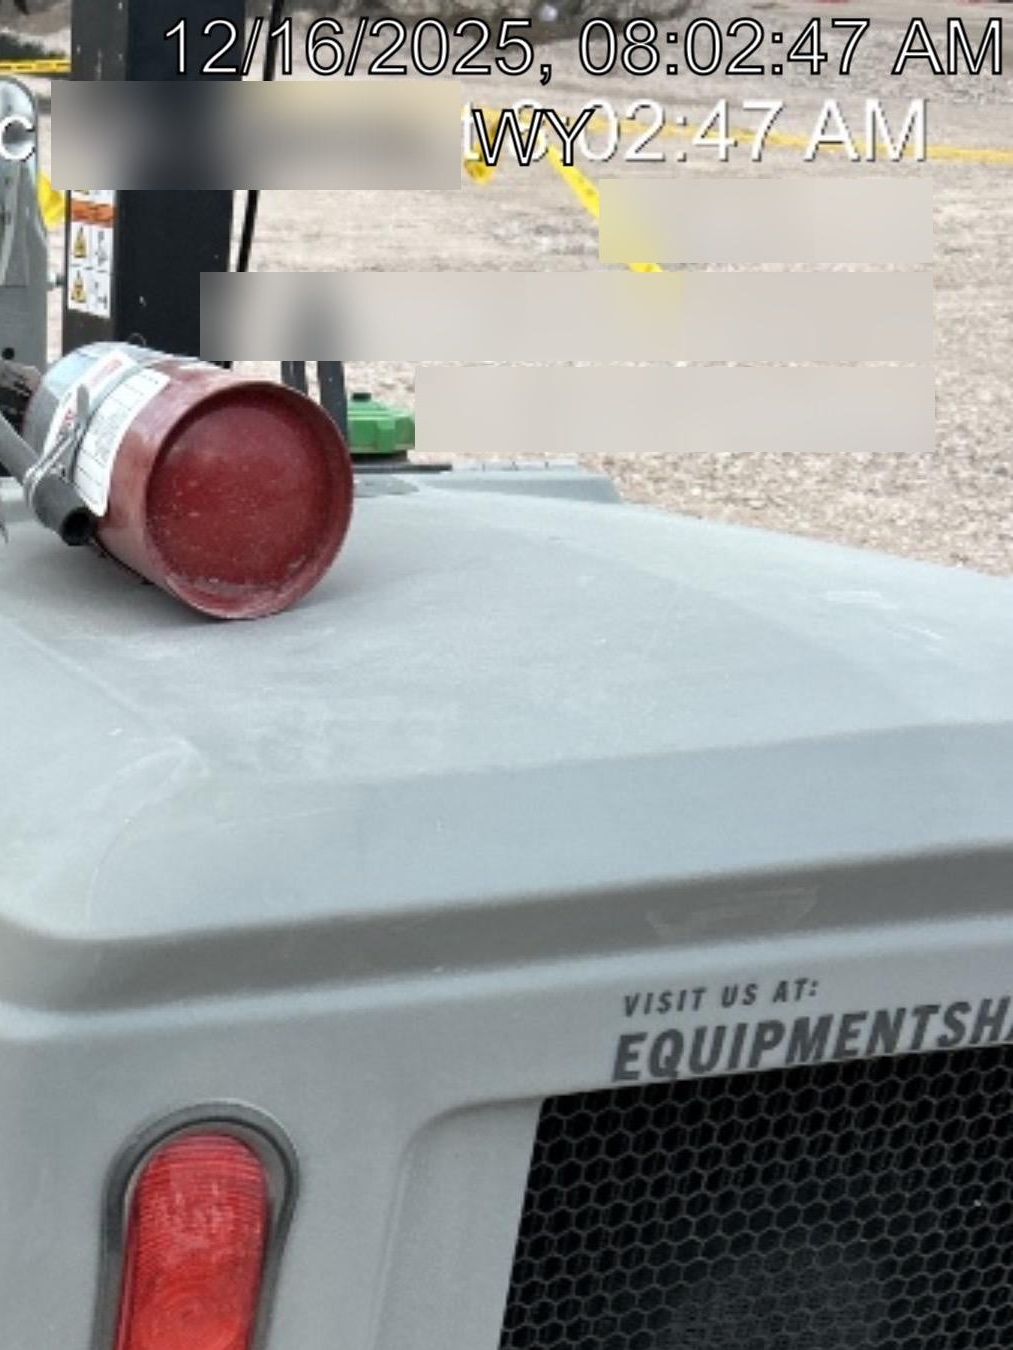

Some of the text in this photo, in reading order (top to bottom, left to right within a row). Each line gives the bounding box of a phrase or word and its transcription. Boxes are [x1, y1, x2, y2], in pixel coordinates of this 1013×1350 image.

[623, 977, 820, 1018] VISIT US AT:
